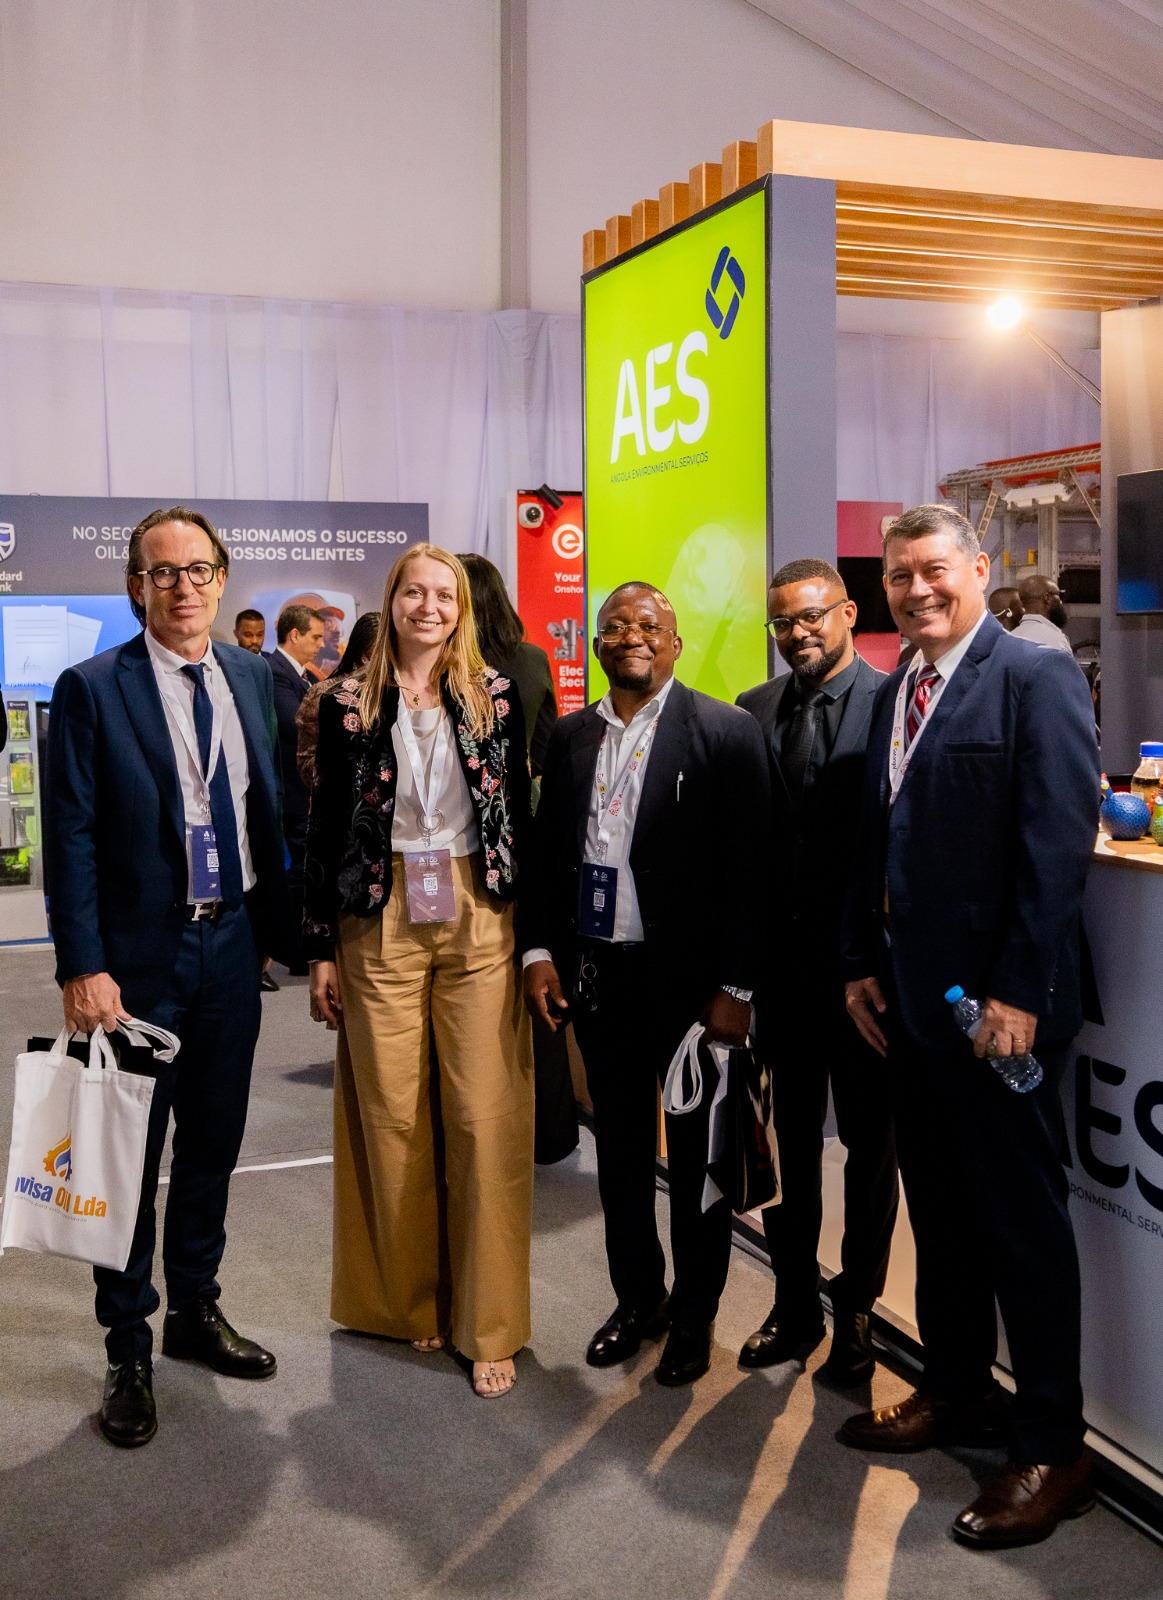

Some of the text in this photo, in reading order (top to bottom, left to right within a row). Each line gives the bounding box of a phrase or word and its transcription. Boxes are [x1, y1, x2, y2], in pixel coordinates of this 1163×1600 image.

[610, 330, 710, 464] AES
[610, 451, 709, 483] ANGOLA ENVIRONMENTAL SERVIÇOS
[72, 526, 97, 540] NO
[101, 526, 136, 541] SEC
[320, 529, 333, 543] O
[336, 530, 408, 544] SUCESSO
[291, 547, 366, 561] CLIENTES
[554, 572, 582, 583] Your
[73, 1195, 107, 1217] Lda
